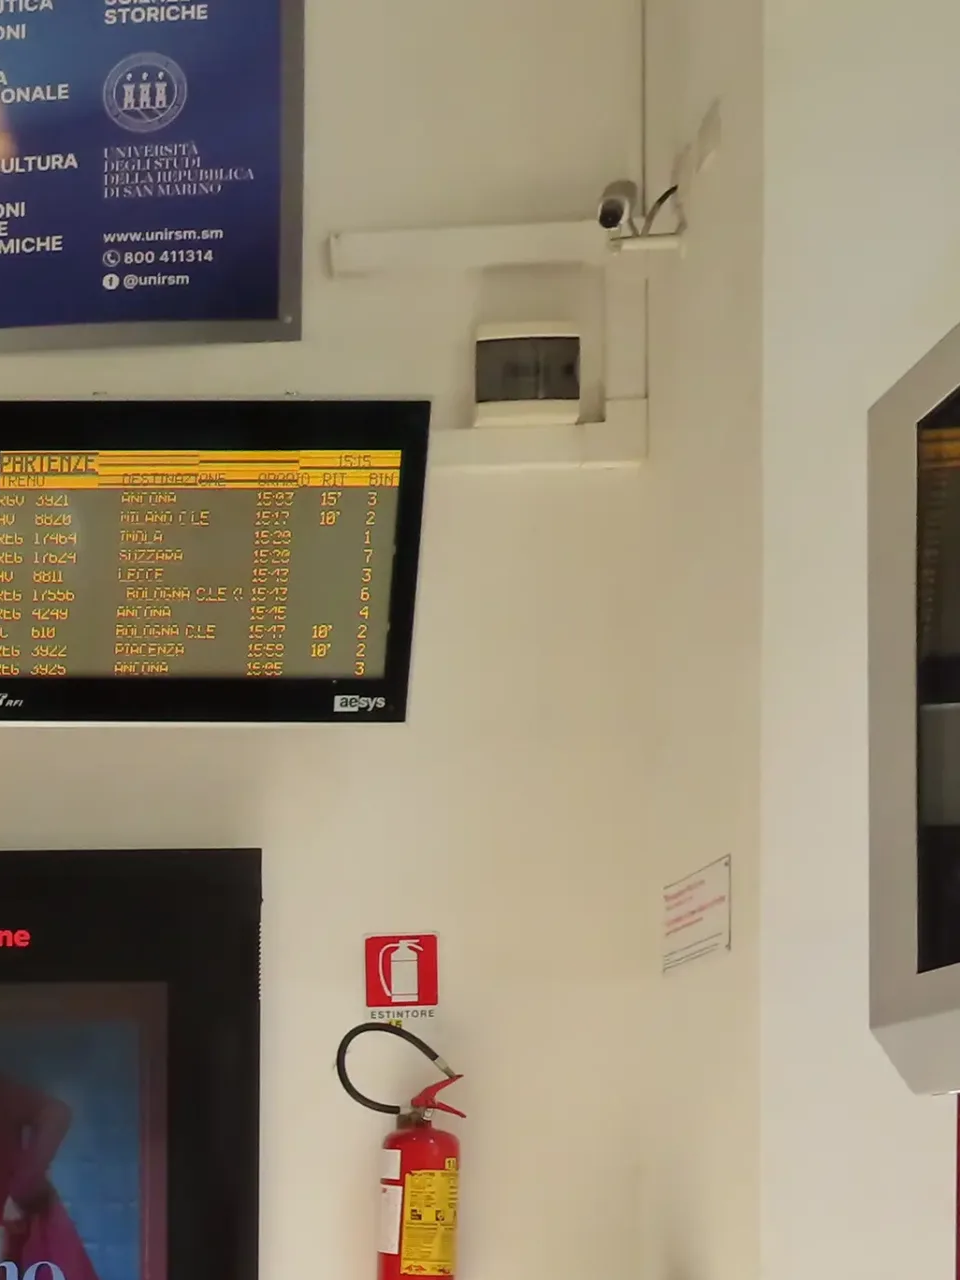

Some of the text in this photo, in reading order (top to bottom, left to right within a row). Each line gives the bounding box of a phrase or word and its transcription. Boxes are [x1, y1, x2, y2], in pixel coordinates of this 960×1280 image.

[104, 4, 208, 25] STORICHE
[104, 140, 198, 158] UNIVERSITÀ
[104, 156, 201, 172] DEGLI STUDI
[104, 168, 255, 186] DELLA REPUBBLICA
[104, 182, 222, 198] DI SAN MARINO
[103, 228, 224, 243] www.unirsm.sm
[124, 250, 214, 264] 800 411314
[123, 272, 190, 290] @unirsm
[0, 454, 371, 474] PARTENZE 15:15
[323, 472, 347, 486] RIT
[369, 472, 394, 486] BIN
[367, 492, 377, 506] 3
[366, 511, 376, 526] 2
[364, 530, 371, 544] 1
[362, 549, 373, 563] 7
[362, 567, 372, 582] 3
[360, 587, 370, 601] 6
[359, 605, 369, 620] 4
[357, 624, 367, 639] 2
[356, 643, 366, 657] 2
[354, 661, 365, 676] 3
[338, 696, 386, 712] aesys
[370, 1009, 435, 1019] ESTINTORE
